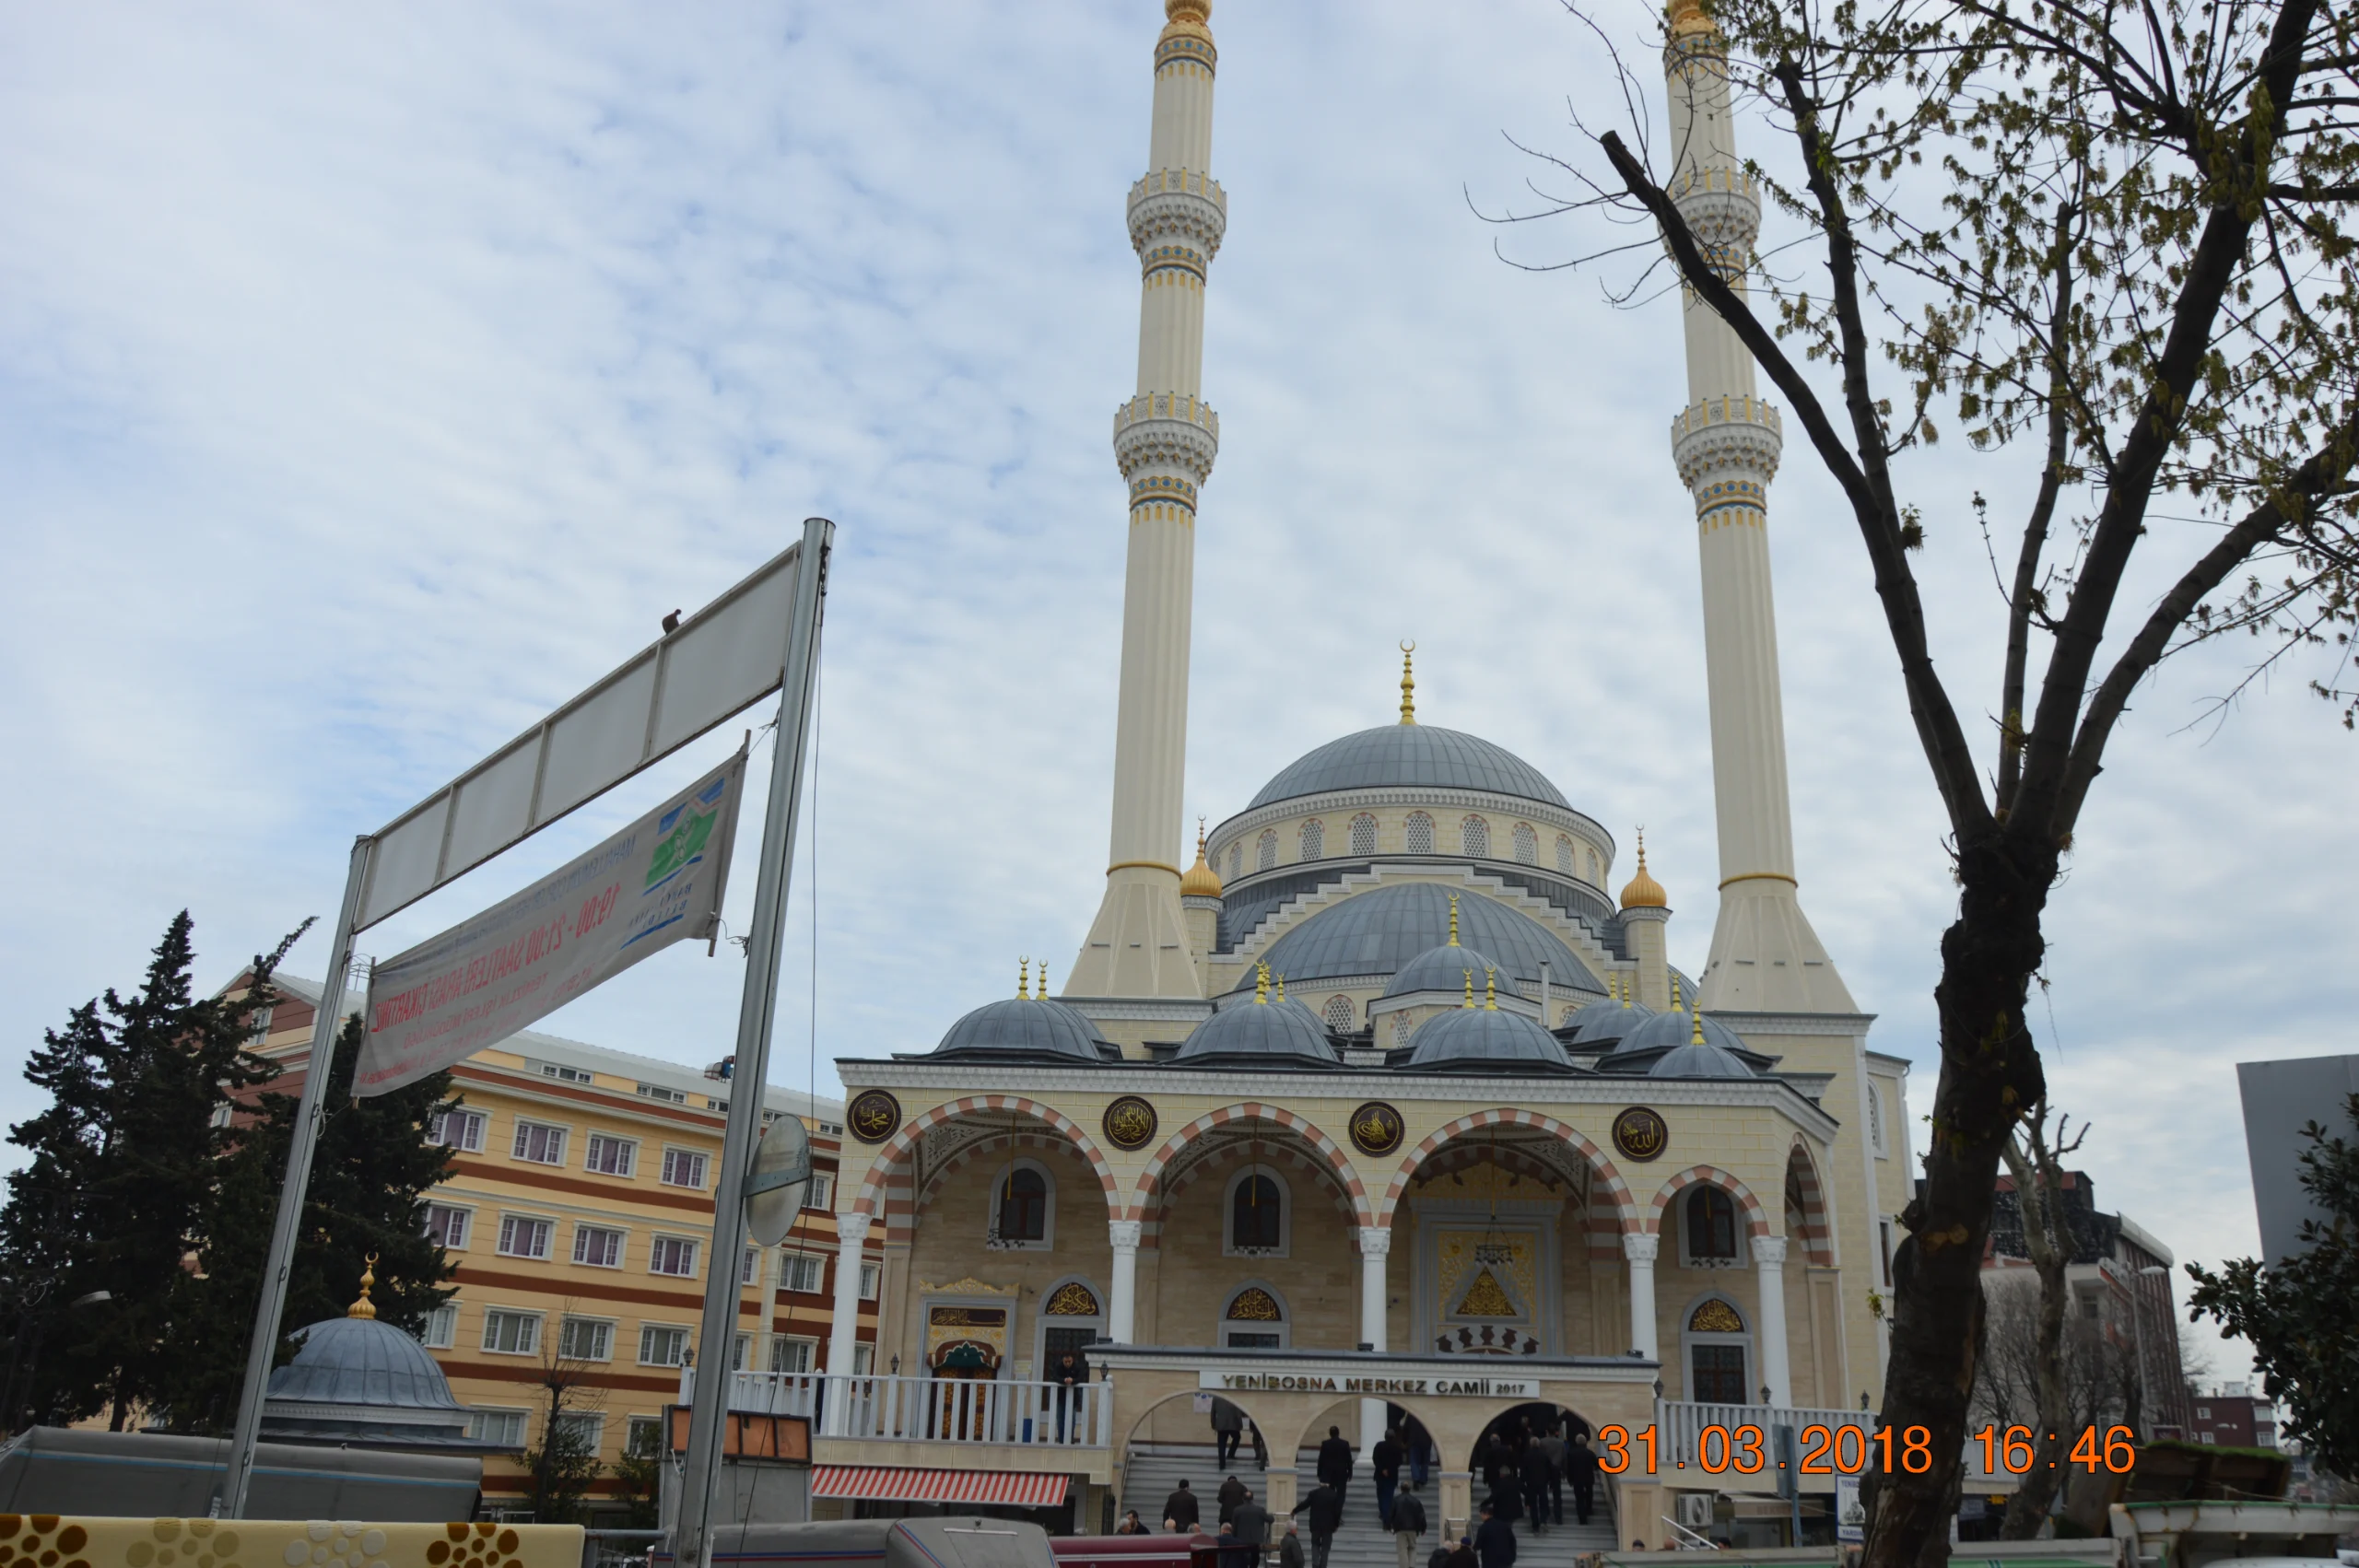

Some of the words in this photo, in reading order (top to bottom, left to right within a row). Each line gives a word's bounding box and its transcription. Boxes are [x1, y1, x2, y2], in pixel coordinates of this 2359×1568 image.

[1222, 1372, 1336, 1390] YENİBOSNA
[1345, 1378, 1427, 1394] MERKEZ
[1496, 1383, 1526, 1395] 2017
